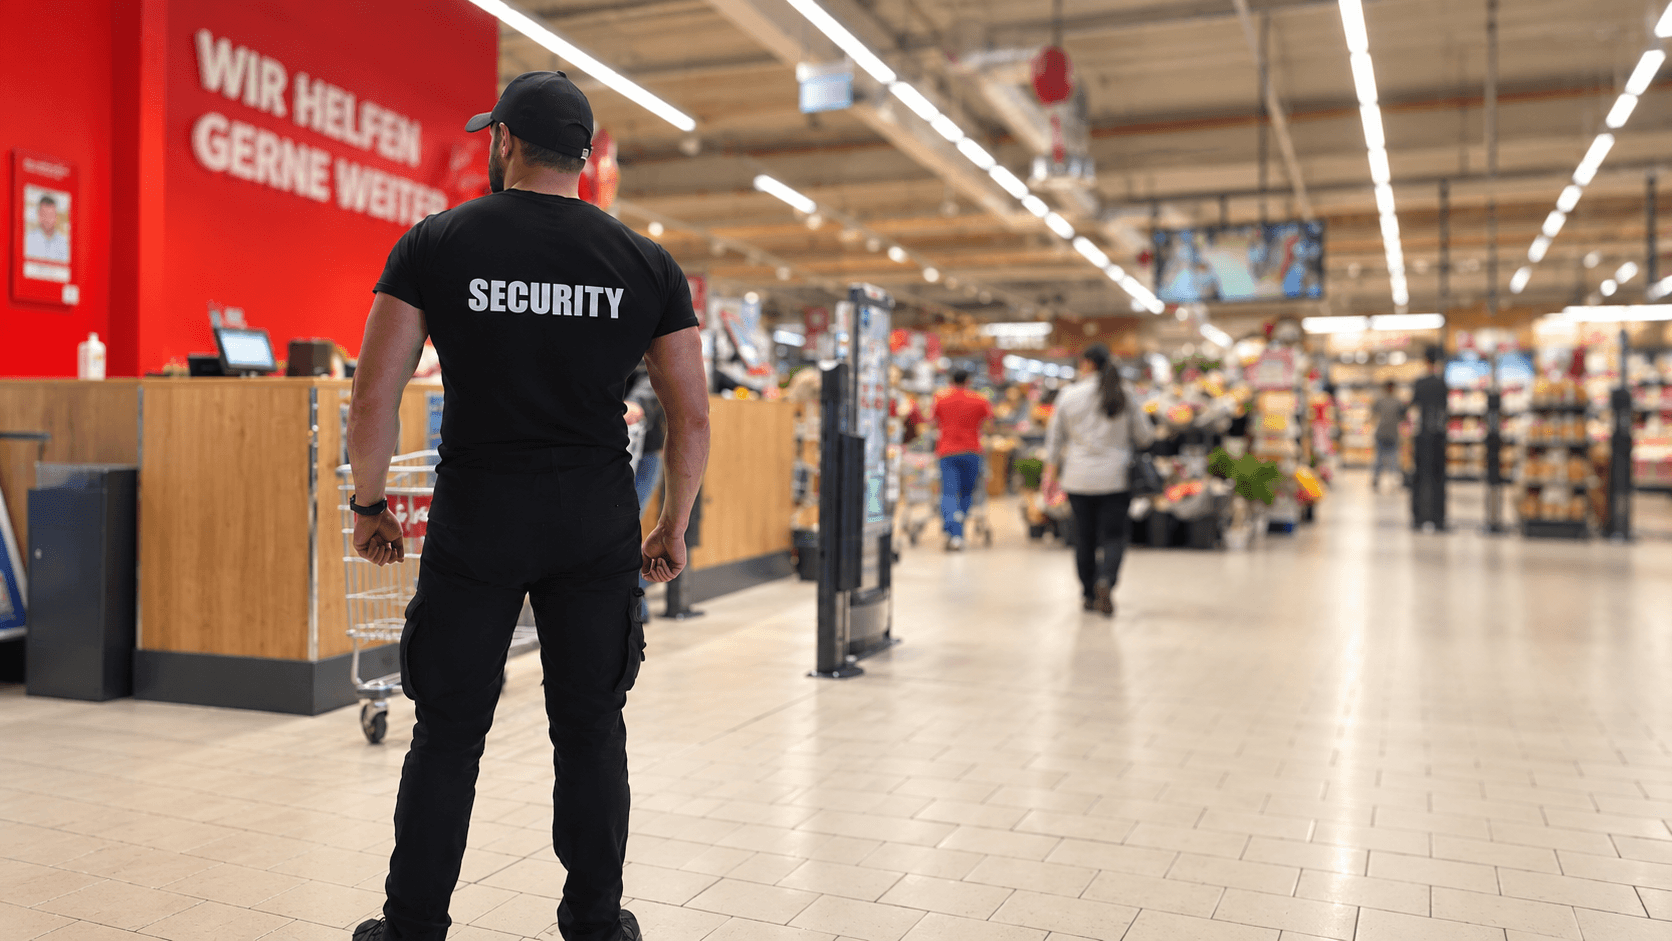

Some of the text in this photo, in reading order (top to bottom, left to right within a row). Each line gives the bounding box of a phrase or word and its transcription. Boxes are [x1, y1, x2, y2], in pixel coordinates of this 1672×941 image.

[195, 28, 422, 168] WIR HELFEN
[191, 112, 449, 227] GERNE WEITER
[468, 278, 624, 319] SECURITY
